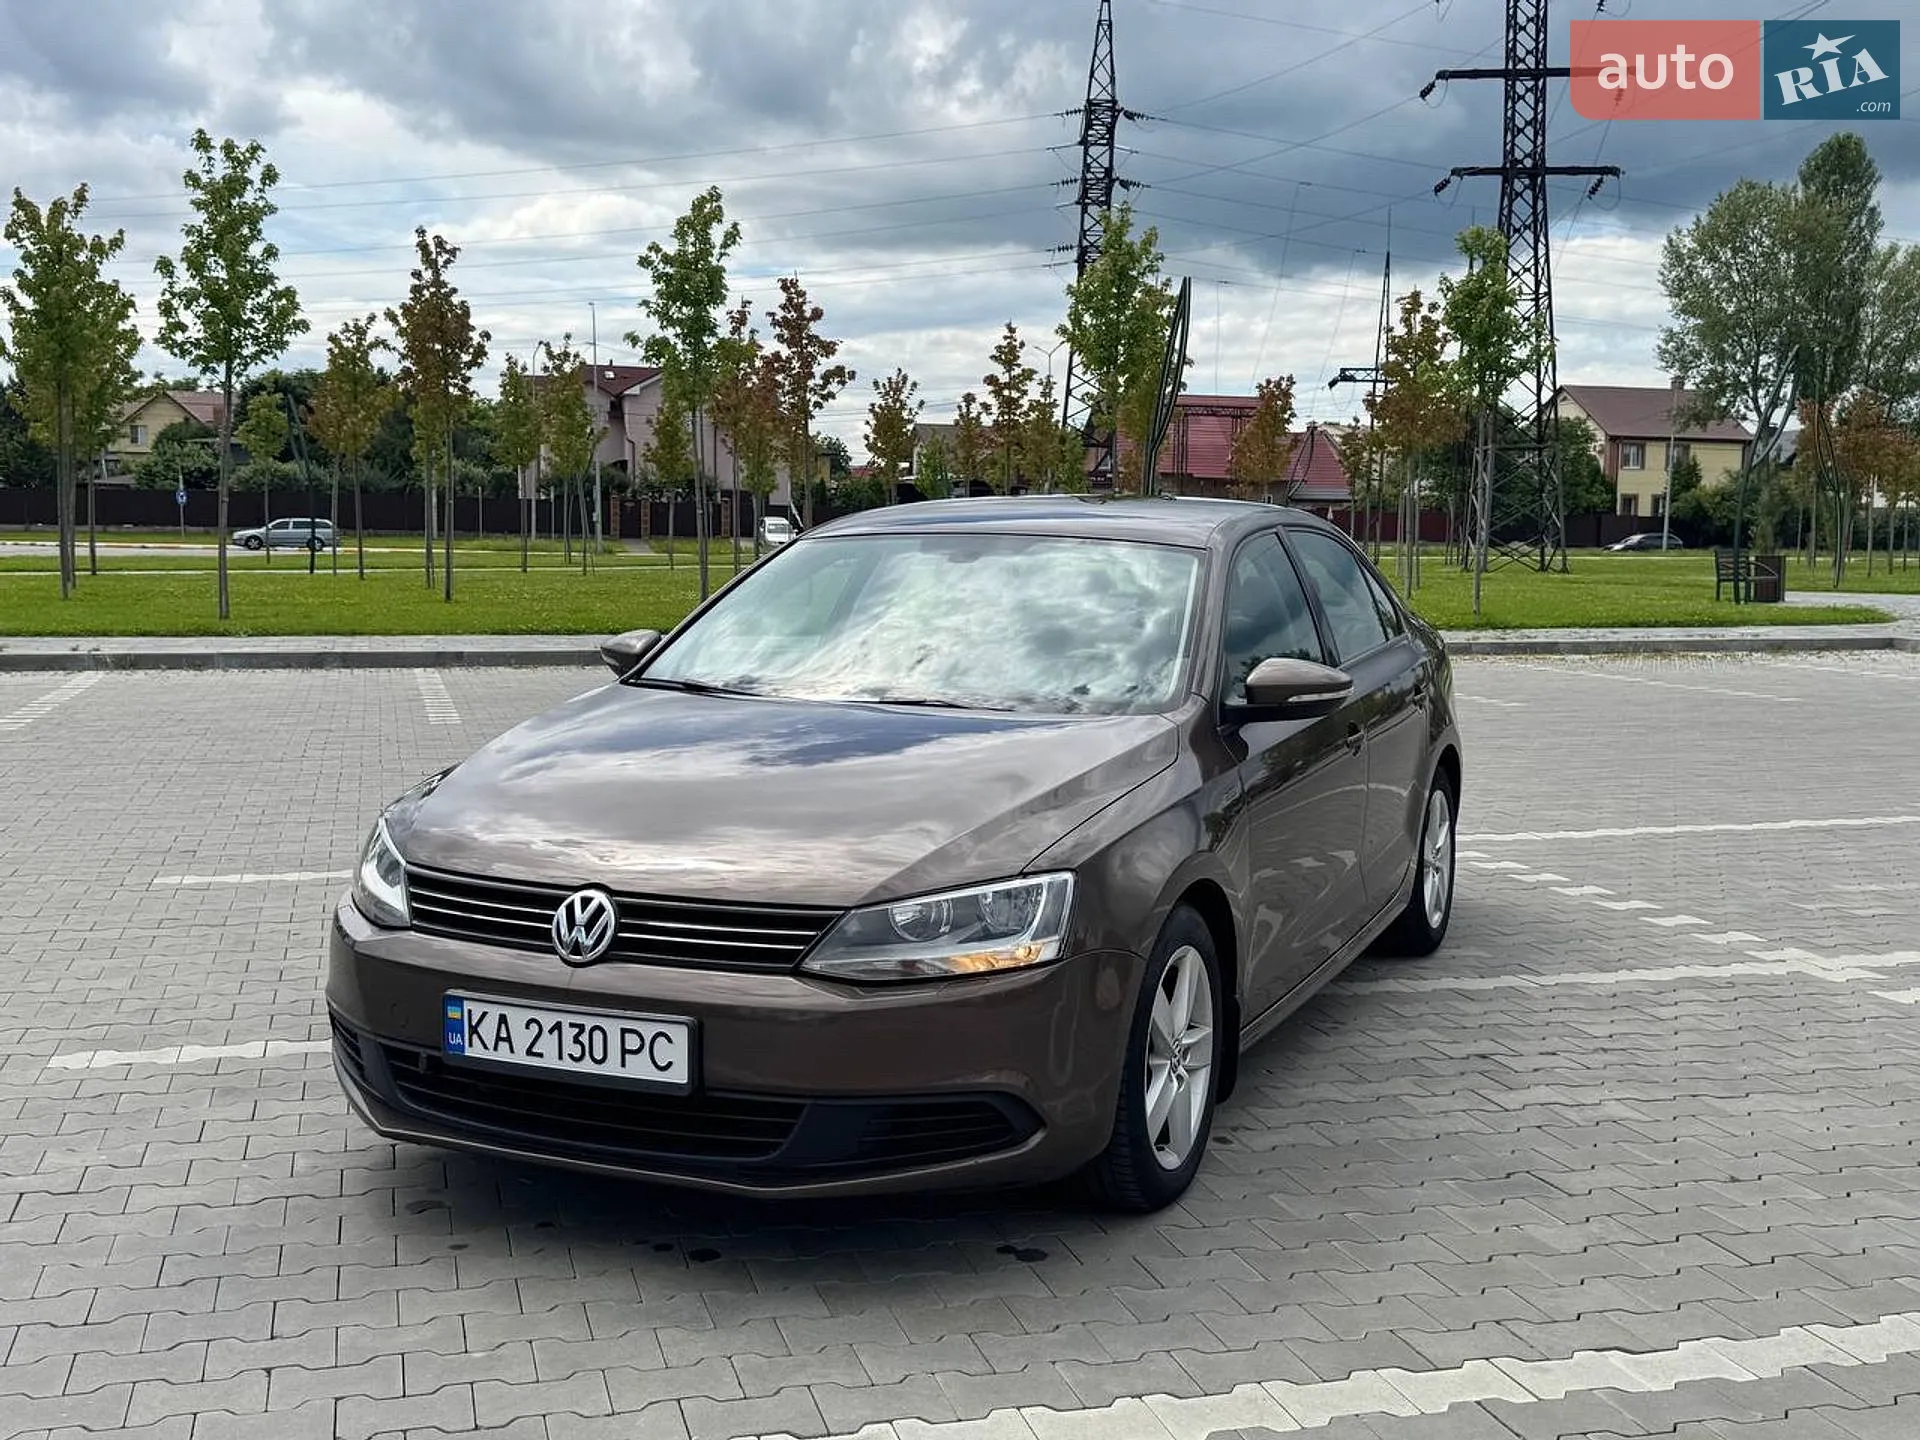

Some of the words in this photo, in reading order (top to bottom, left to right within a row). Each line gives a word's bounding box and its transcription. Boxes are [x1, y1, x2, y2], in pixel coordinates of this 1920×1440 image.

[448, 1032, 463, 1046] UA
[467, 1009, 515, 1054] KA
[524, 1017, 608, 1066] 2130
[620, 1027, 674, 1072] PC
